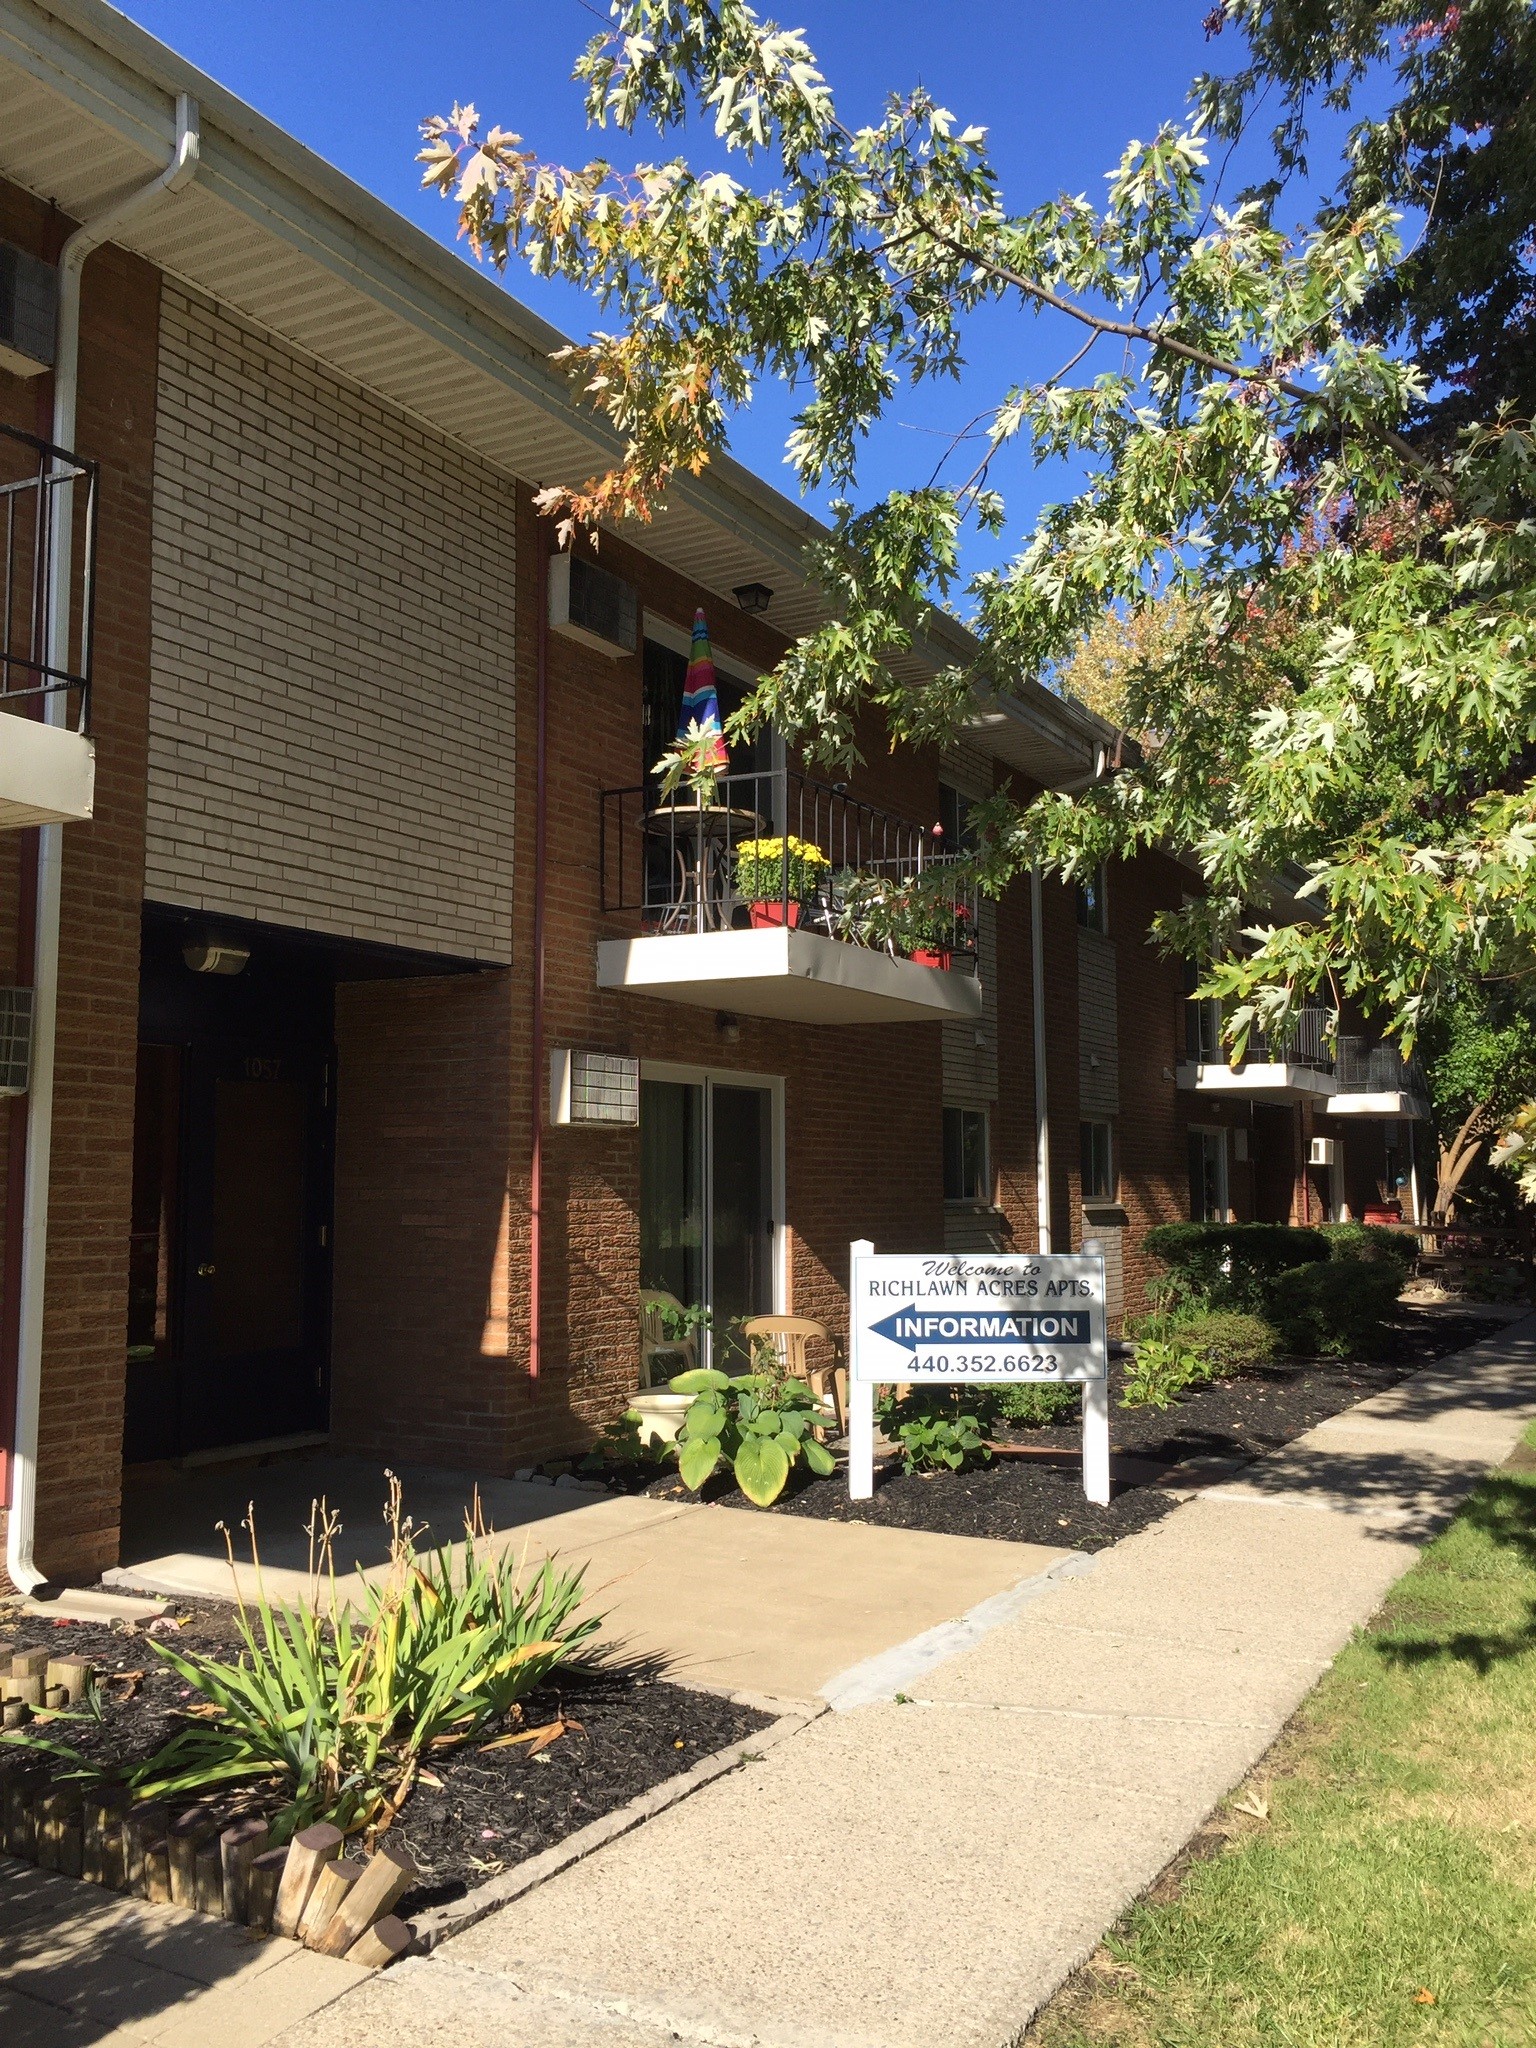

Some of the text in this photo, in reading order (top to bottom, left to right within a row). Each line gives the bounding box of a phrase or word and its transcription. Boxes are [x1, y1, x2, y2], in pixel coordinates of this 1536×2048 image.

[922, 1260, 1042, 1276] Welcome to
[869, 1280, 1095, 1296] RICHLAWN ACRES APTS.
[896, 1317, 1079, 1338] INFORMATION
[907, 1355, 1059, 1373] 440.352.6623
